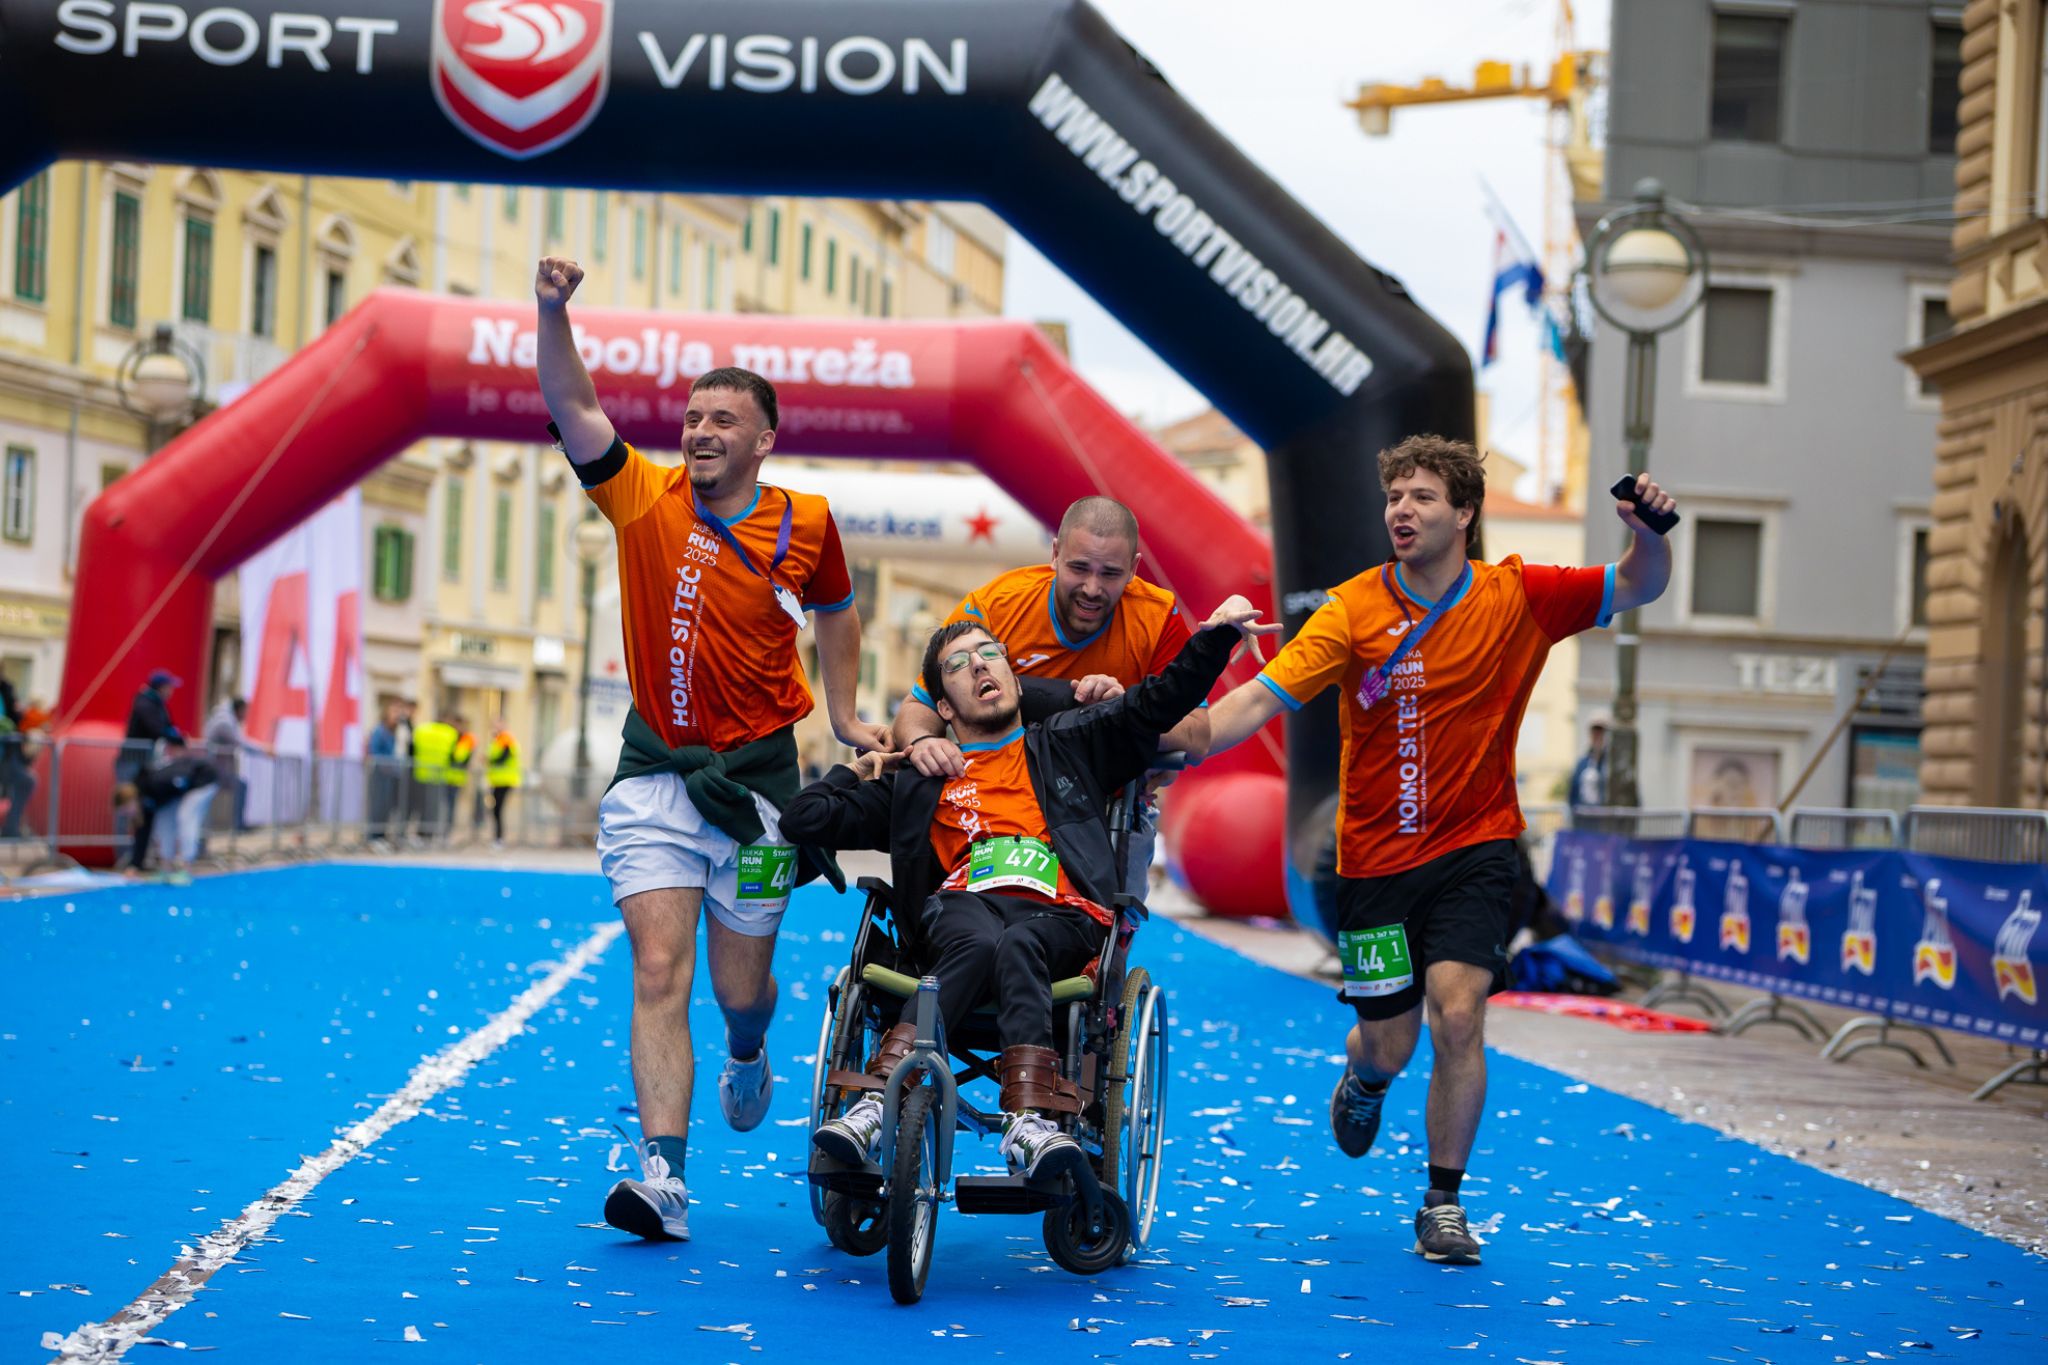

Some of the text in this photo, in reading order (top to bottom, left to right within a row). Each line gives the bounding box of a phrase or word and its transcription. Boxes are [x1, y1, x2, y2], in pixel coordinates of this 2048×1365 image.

[56, 0, 968, 94] SPORT VISION
[1029, 73, 1374, 397] WWW.SPORTVISION.HR
[467, 316, 915, 389] Nabolja mreža
[687, 532, 720, 555] RUN
[683, 545, 718, 567] 2025
[669, 565, 701, 727] HOMO SI TEĆ
[1393, 675, 1426, 690] 2025
[1398, 737, 1418, 758] SI
[1398, 763, 1418, 833] HOMO
[741, 857, 763, 865] RUN
[974, 847, 993, 857] RUN
[1005, 848, 1050, 872] 477
[1358, 940, 1399, 975] 44 1
